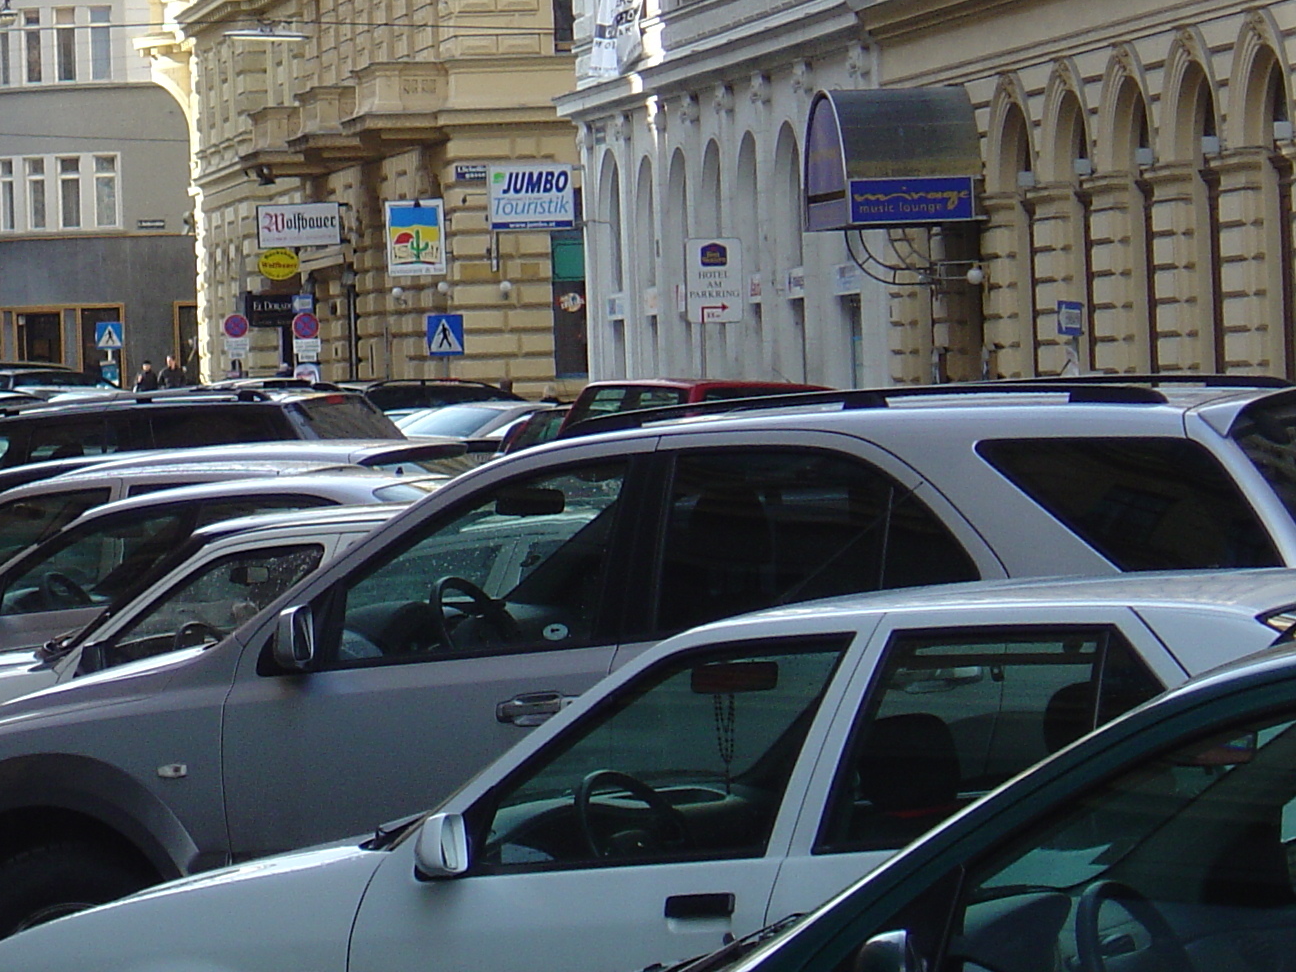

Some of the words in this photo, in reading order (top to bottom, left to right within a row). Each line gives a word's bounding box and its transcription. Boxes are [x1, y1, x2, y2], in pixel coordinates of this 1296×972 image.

[501, 170, 569, 195] JUMBO
[493, 195, 570, 216] Touristik
[859, 202, 895, 214] music
[899, 200, 942, 213] lounge
[262, 212, 337, 234] Wolfbauer
[698, 271, 728, 279] HOTEL
[689, 290, 740, 299] PARKRING
